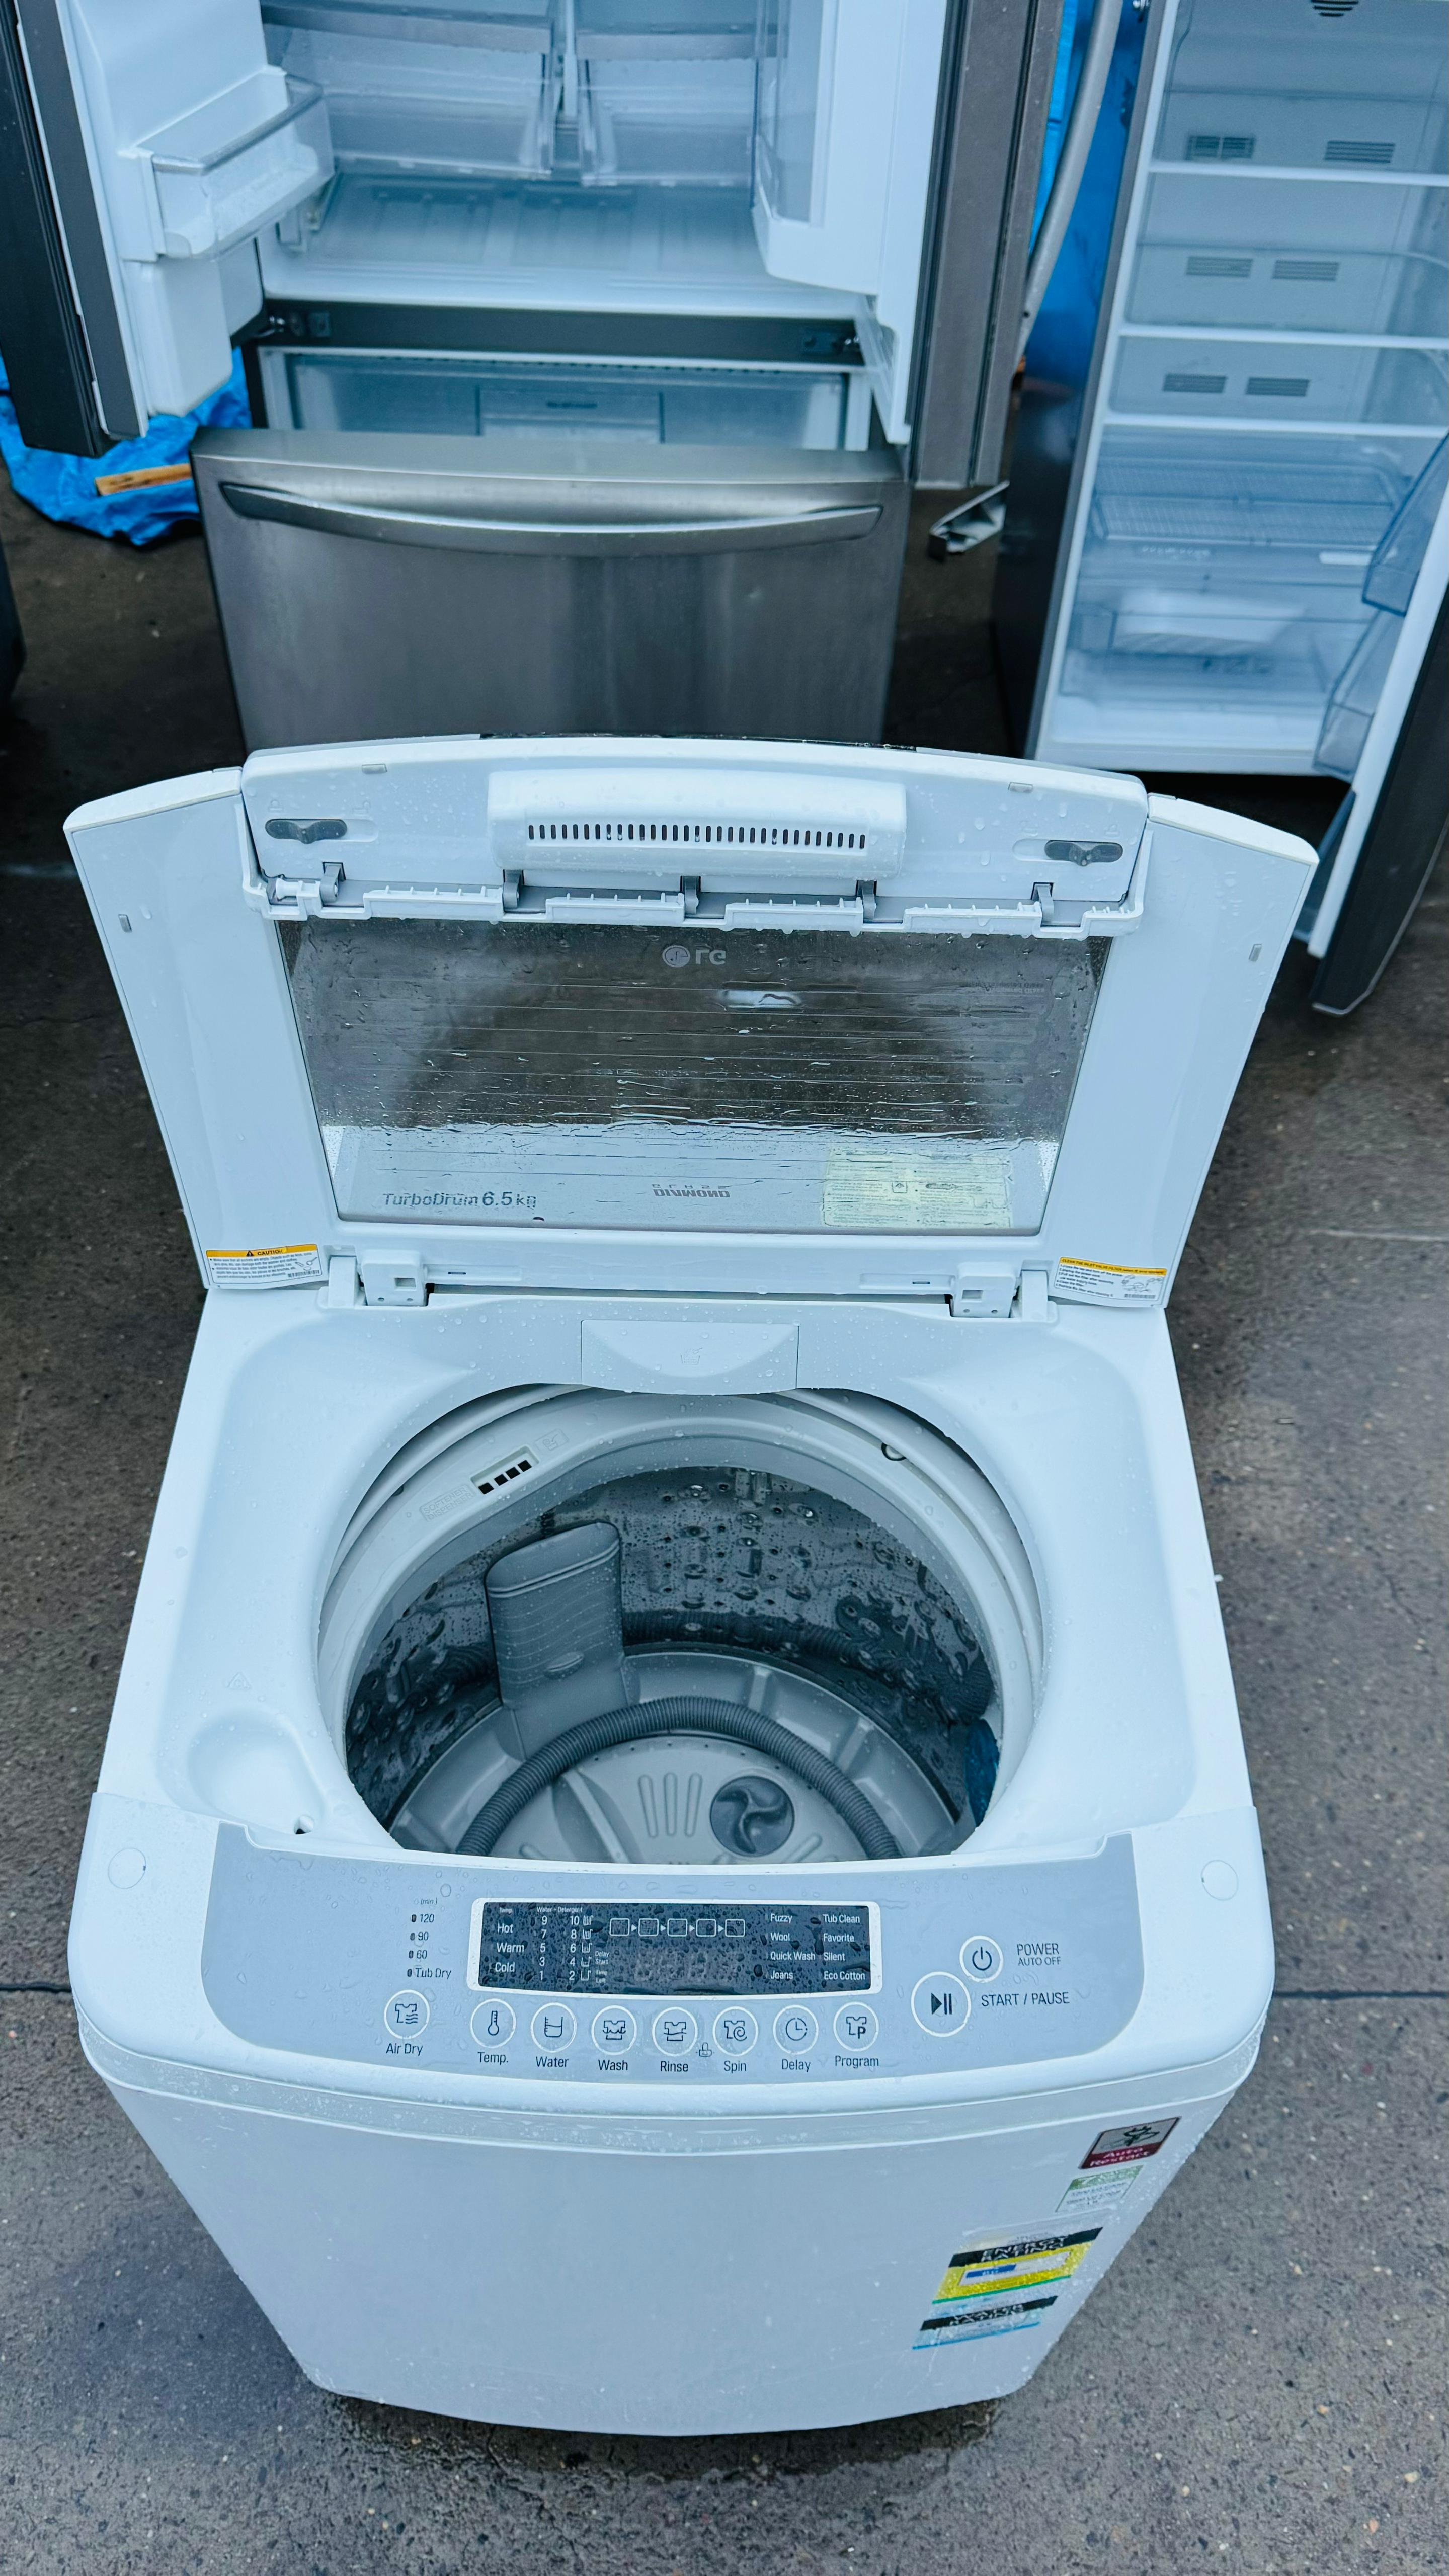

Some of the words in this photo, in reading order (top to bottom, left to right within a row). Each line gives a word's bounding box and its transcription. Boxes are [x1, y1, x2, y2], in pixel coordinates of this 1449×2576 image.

[383, 1193, 478, 1206] TurboDrum
[424, 1487, 466, 1514] SOFTENER
[426, 1492, 474, 1520] DISPENSER
[420, 1914, 435, 1923] 120
[542, 1915, 547, 1925] 9
[570, 1915, 580, 1925] 10
[770, 1913, 792, 1923] Fuzzy
[823, 1914, 837, 1923] Tub
[839, 1914, 860, 1923] Clean
[497, 1922, 514, 1933] Hot
[418, 1931, 429, 1941] 90
[541, 1930, 547, 1939] 7
[571, 1929, 577, 1939] 8
[770, 1933, 790, 1942] Wool
[823, 1933, 855, 1942] Favorite
[497, 1943, 525, 1953] Warm
[540, 1943, 546, 1953] 5
[570, 1943, 576, 1953] 6
[1017, 1943, 1059, 1956] POWER
[417, 1950, 427, 1959] 60
[770, 1952, 792, 1961] Quick
[793, 1952, 816, 1960] Wash
[823, 1952, 845, 1961] Silent
[539, 1957, 545, 1966] 3
[570, 1956, 576, 1967] 4
[1018, 1957, 1042, 1966] AUTO
[1044, 1957, 1061, 1965] OFF
[495, 1962, 515, 1973] Cold
[415, 1968, 433, 1977] Tub
[436, 1968, 452, 1979] Dry
[539, 1972, 543, 1980] 1
[569, 1971, 575, 1981] 2
[824, 1971, 838, 1980] Eco
[839, 1971, 865, 1980] Cotton
[981, 1994, 1019, 2006] START
[1032, 1992, 1070, 2005] PAUSE
[386, 2043, 401, 2054] Air
[405, 2043, 423, 2056] Dry
[477, 2052, 509, 2065] Temp.
[535, 2056, 569, 2068] Water
[835, 2055, 879, 2069] Program
[598, 2059, 628, 2071] Wash
[660, 2060, 689, 2072] Rinse
[723, 2060, 747, 2073] Spin
[781, 2058, 811, 2072] Delay
